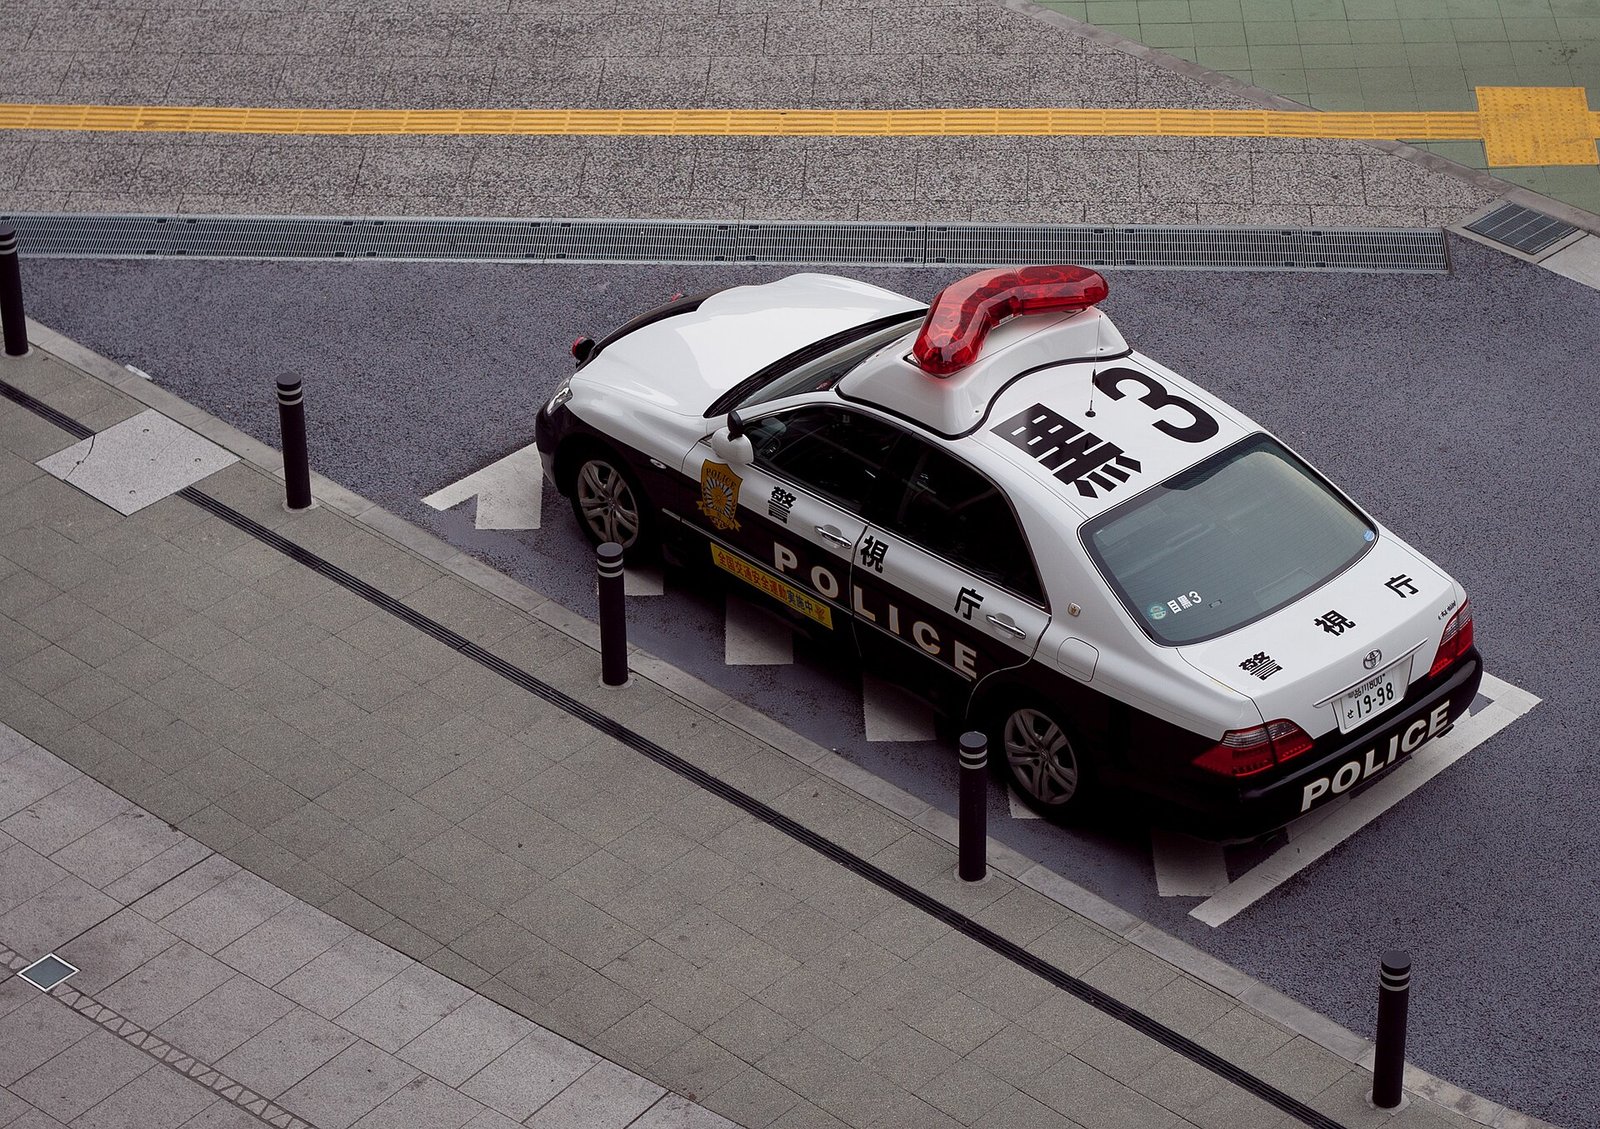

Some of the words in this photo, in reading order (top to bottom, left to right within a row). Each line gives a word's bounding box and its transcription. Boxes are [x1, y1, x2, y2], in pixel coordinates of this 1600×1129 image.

[706, 468, 737, 490] POLICE
[773, 541, 978, 680] POLICE
[1356, 682, 1394, 719] 19-98
[1300, 699, 1451, 813] POLICE
